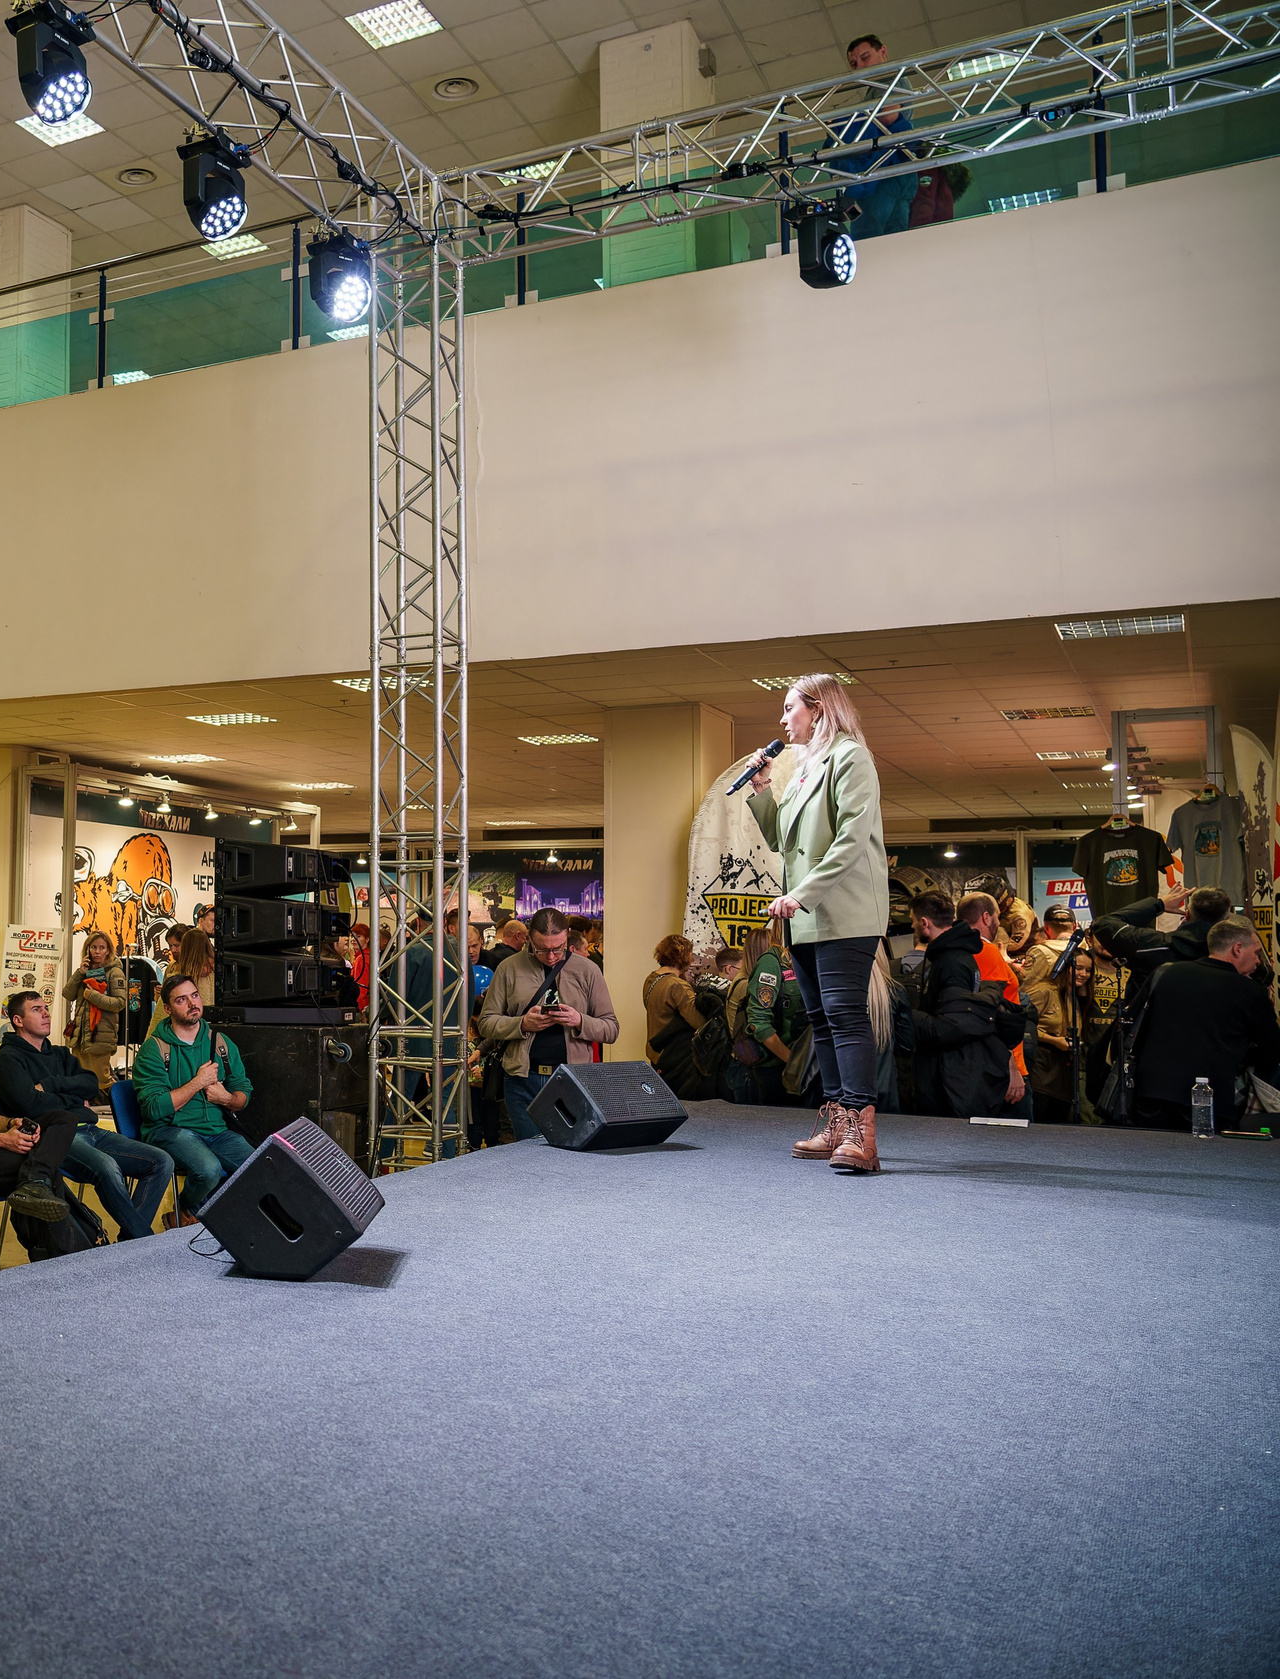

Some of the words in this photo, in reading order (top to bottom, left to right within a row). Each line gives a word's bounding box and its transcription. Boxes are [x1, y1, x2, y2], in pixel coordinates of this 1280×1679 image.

[138, 808, 191, 832] ПОЕХАЛИ
[192, 873, 214, 892] ЧЕР
[1094, 988, 1119, 998] ROJEC
[1099, 998, 1110, 1008] 18
